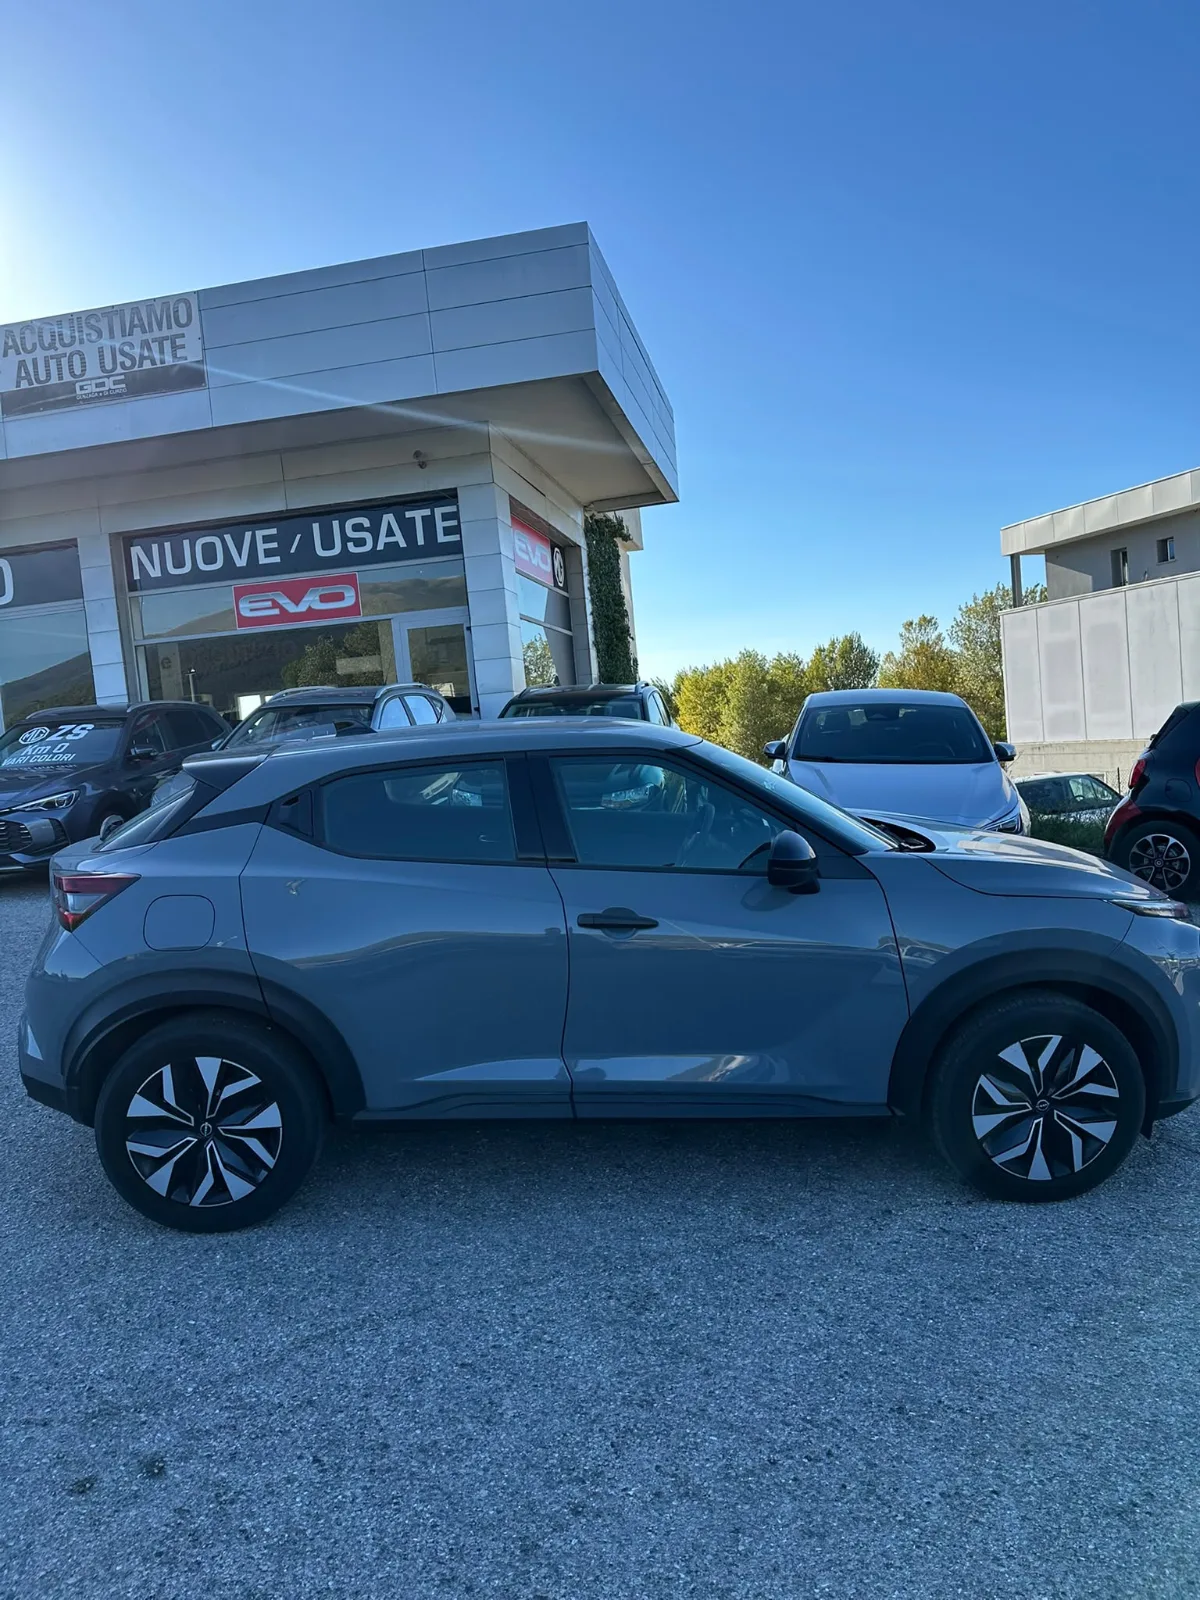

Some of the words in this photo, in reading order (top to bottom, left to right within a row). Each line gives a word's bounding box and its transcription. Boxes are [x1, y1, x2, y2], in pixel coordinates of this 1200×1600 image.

[2, 298, 193, 358] ACQUISTIAMO
[15, 350, 87, 388] AUTO
[97, 333, 187, 374] USATE
[131, 528, 281, 580] NUOVE
[312, 505, 461, 558] USATE
[514, 530, 551, 573] EVO
[238, 584, 357, 617] EVO
[21, 745, 51, 756] Km
[47, 724, 95, 740] ZS
[2, 756, 30, 767] VARI
[30, 754, 76, 763] COLORI
